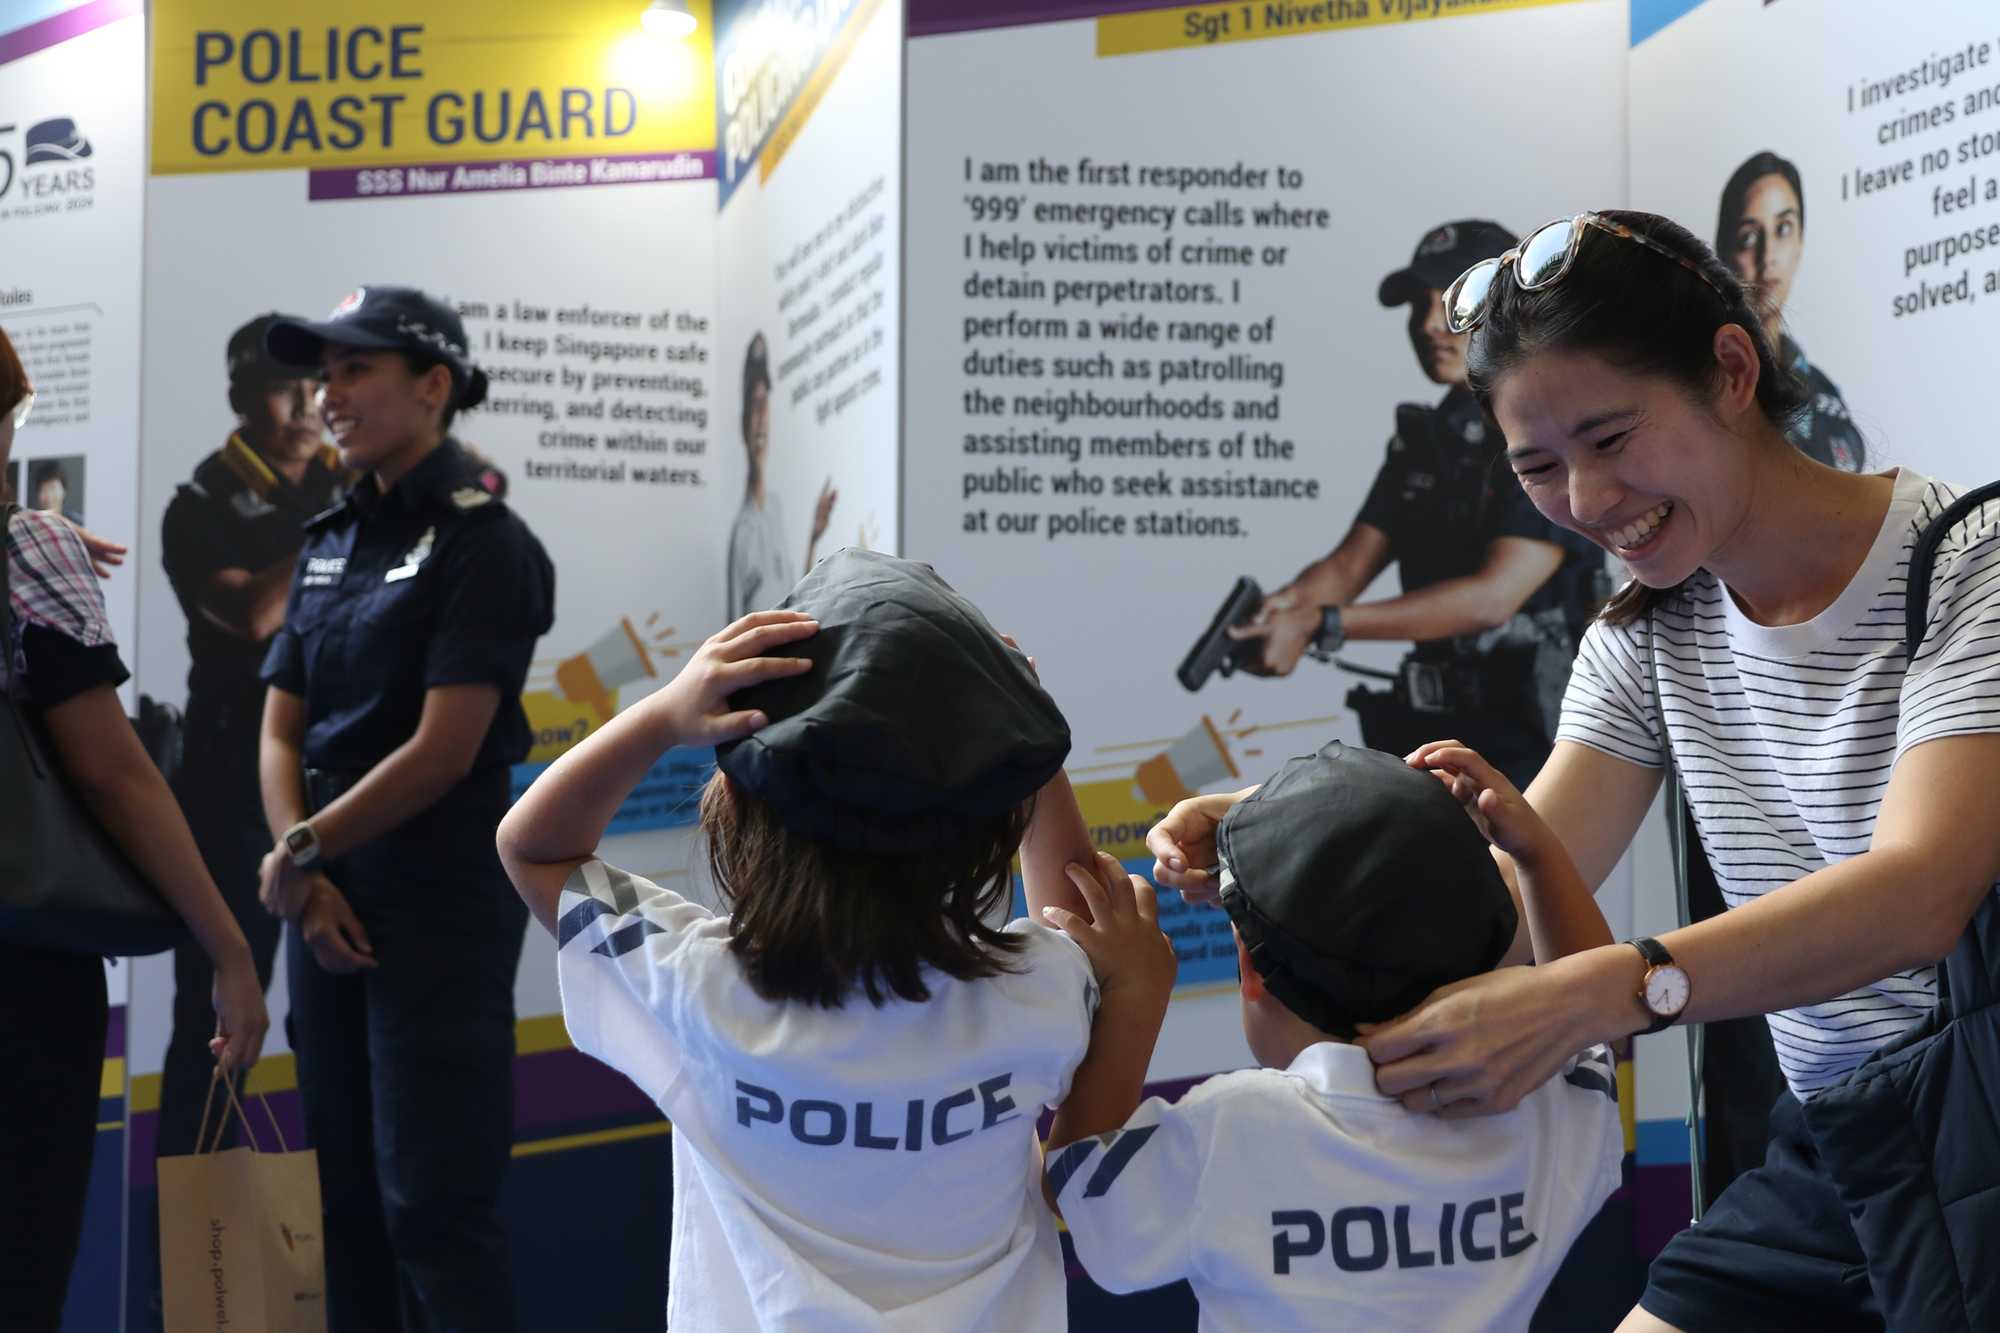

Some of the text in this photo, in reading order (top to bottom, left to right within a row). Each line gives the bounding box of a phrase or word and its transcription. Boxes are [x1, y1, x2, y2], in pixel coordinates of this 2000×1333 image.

[1184, 11, 1229, 41] Sgt
[1265, 0, 1368, 30] Nivetha
[195, 25, 424, 86] POLICE
[1847, 41, 1991, 113] I investigate
[192, 87, 637, 156] COAST GUARD
[1877, 100, 1956, 146] crimes
[21, 168, 95, 198] YEARS
[357, 169, 404, 194] SSS
[407, 167, 448, 192] Nur
[452, 161, 527, 190] Amelia
[590, 153, 704, 183] Kamarudin
[964, 156, 1303, 194] I am the first responder to
[1841, 130, 2000, 201] I leave no sto
[1033, 202, 1175, 231] emergency
[1184, 200, 1245, 227] calls
[1252, 202, 1331, 229] where
[1932, 175, 1976, 218] feel
[964, 234, 1288, 267] I help victims of crime or
[1904, 223, 2000, 278] purpose
[963, 271, 1241, 307] detain perpetrators. I
[1892, 269, 1976, 319] solved,
[458, 299, 708, 332] am a law enforcer of the
[963, 311, 1275, 349] perform a wide range of
[484, 330, 708, 363] I keep Singapore safe
[487, 366, 707, 398] secure by preventing,
[963, 349, 1285, 389] duties such as patrolling
[566, 400, 605, 419] and
[610, 399, 708, 429] detecting
[963, 387, 1280, 425] the neighbourhoods and
[538, 427, 707, 455] crime within our
[963, 427, 1295, 463] assisting members of the
[525, 459, 707, 487] territorial waters.
[962, 466, 1320, 500] public who seek assistance
[962, 506, 1249, 541] at our police stations.
[735, 1072, 1022, 1151] POLICE
[1272, 1192, 1538, 1275] POLICE
